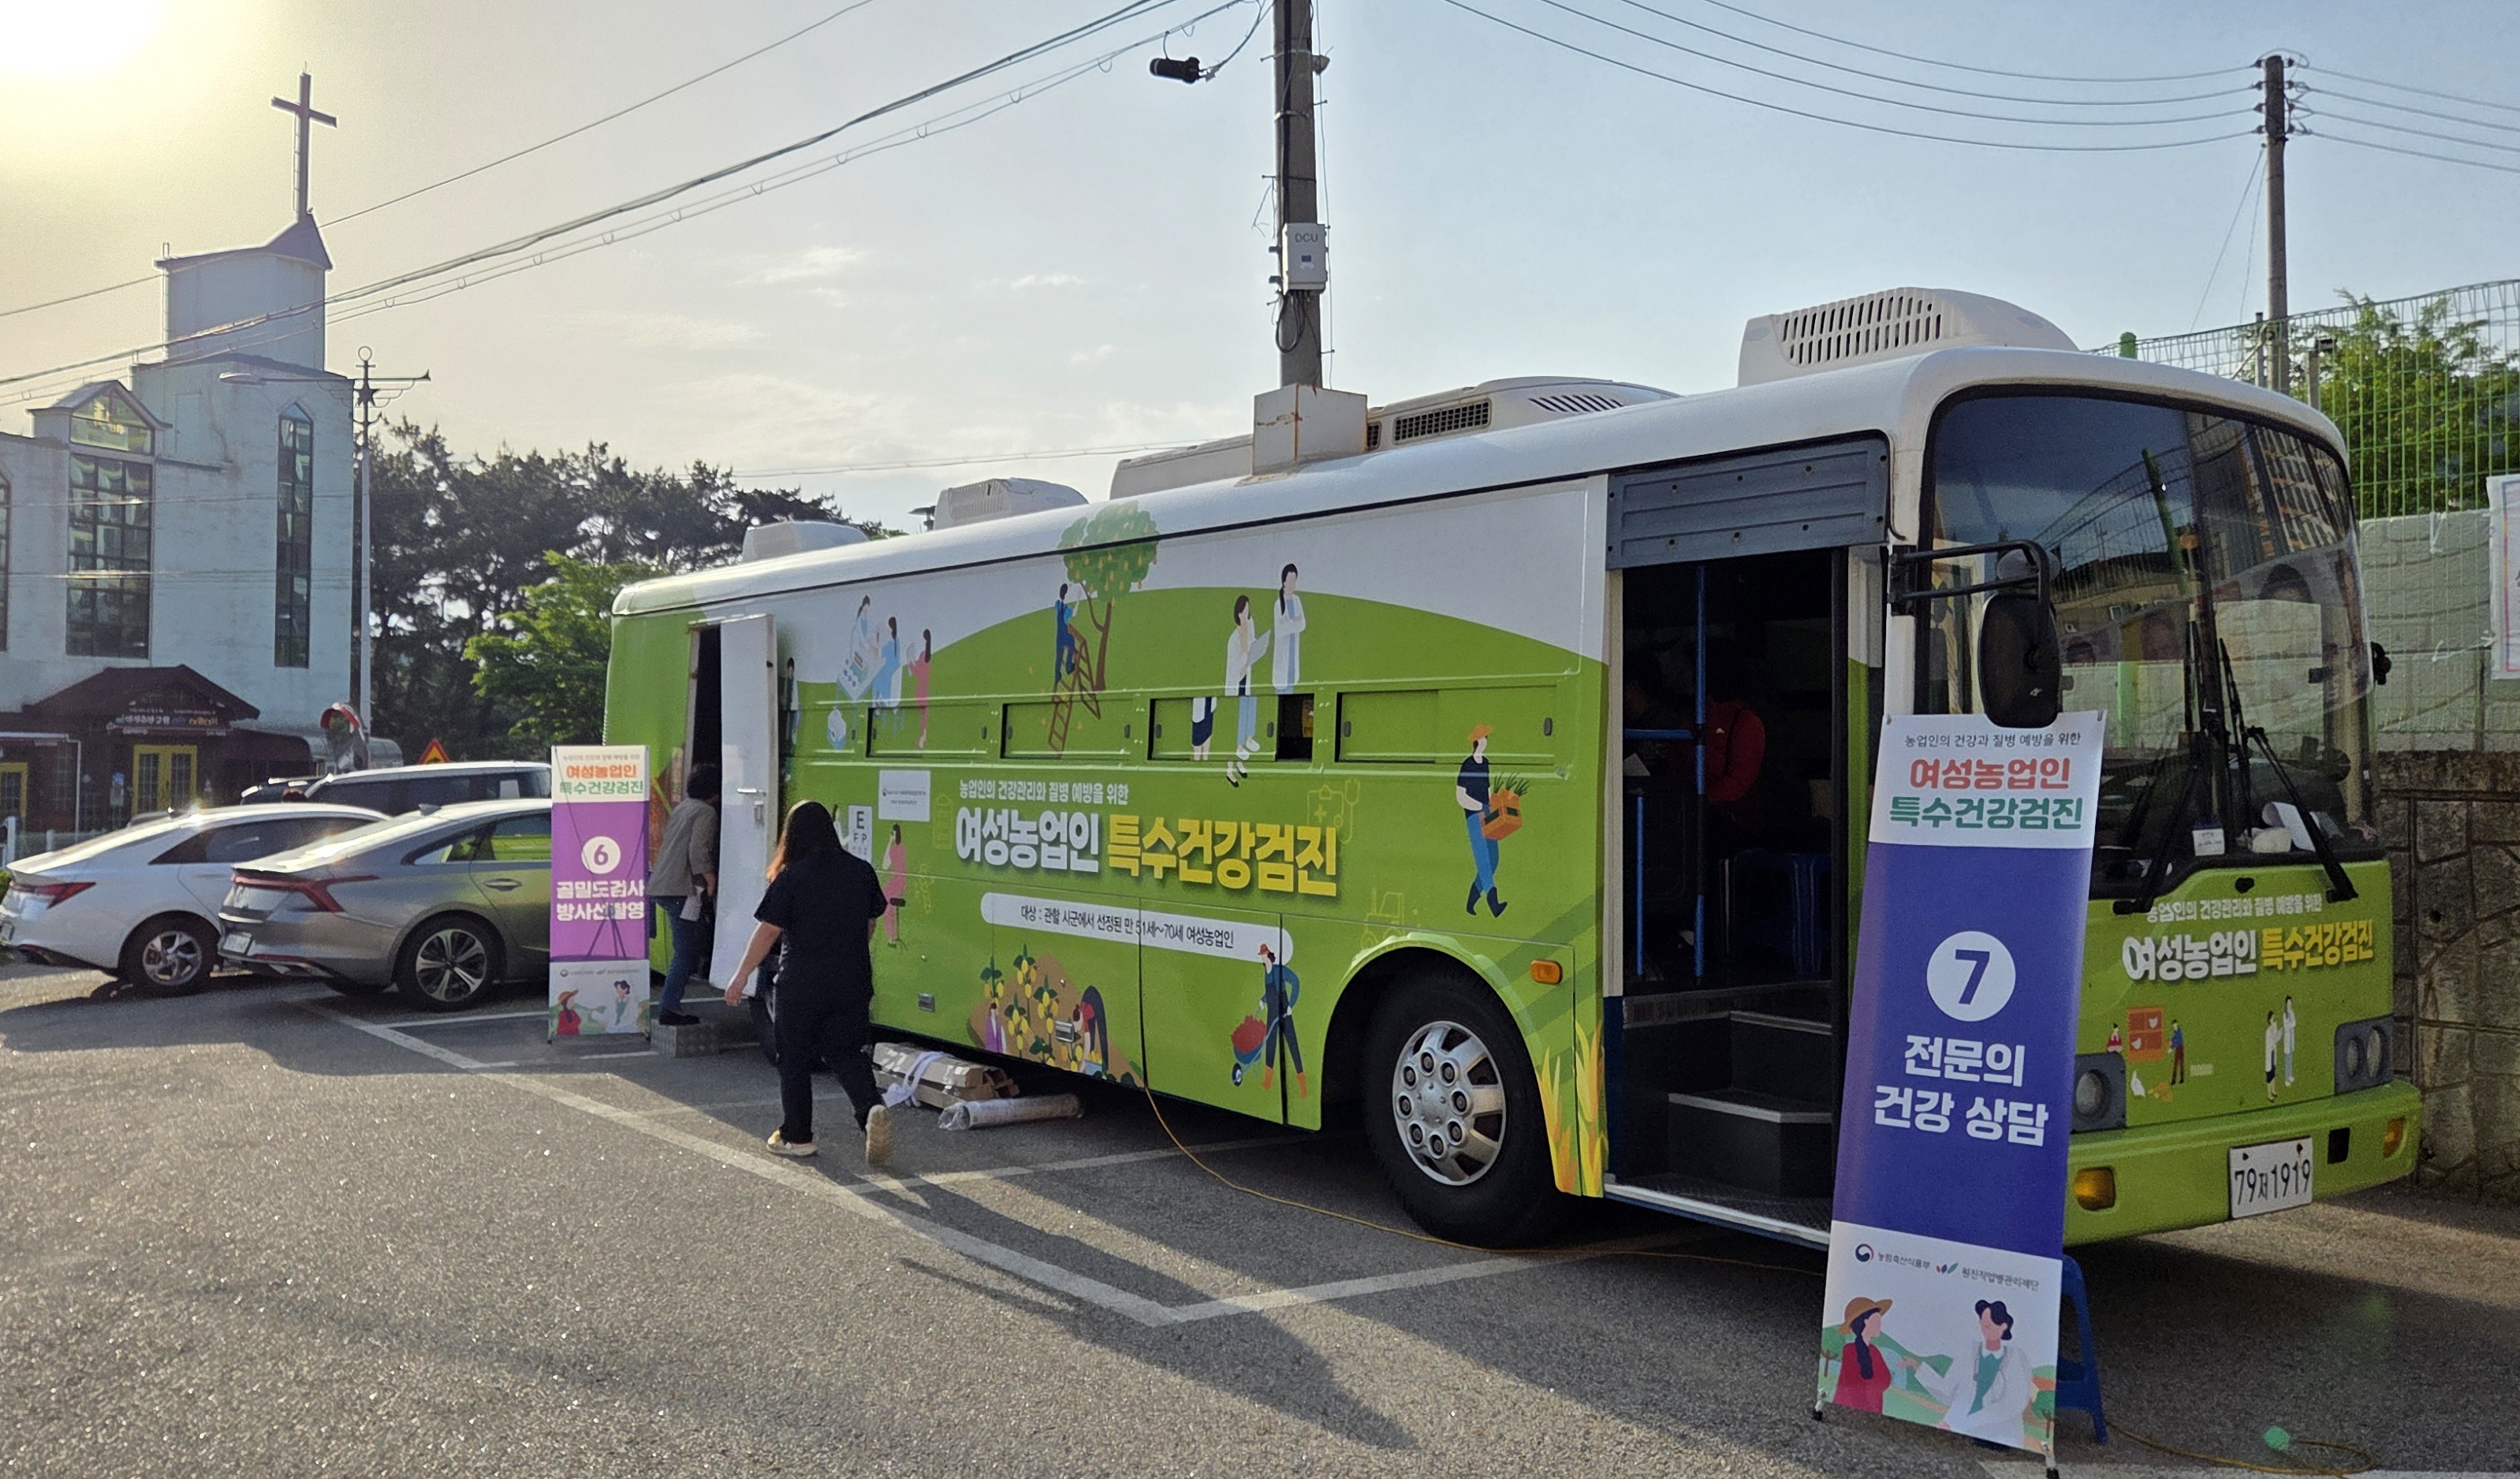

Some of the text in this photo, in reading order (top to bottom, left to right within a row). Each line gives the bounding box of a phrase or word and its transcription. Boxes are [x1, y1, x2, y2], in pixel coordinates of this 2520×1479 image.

[1295, 233, 1318, 243] DCU
[1904, 732, 2081, 748] 농업인의 건강과 질병 예방을 위한
[566, 764, 637, 779] 여성농업인
[1910, 758, 2071, 790] 여성농업인
[559, 780, 643, 795] 특수건강검진
[959, 779, 1129, 805] 농업인의 건강관리와 질병 예방을 위한
[856, 810, 865, 829] E
[1889, 795, 2083, 829] 특수건강검진
[594, 844, 609, 866] 6
[956, 807, 1336, 897] 여성농업인 특수건강검진
[557, 879, 645, 900] 골밀도검사
[1020, 904, 1036, 922] 대상
[1043, 907, 1061, 925] 관할
[1061, 910, 1095, 930] 시군에서
[1097, 914, 1122, 933] 선정된
[1124, 917, 1134, 935] 만
[1186, 926, 1234, 949] 여성농업인
[2122, 918, 2373, 981] 여성농업인 특수건강검진
[1955, 948, 1991, 1005] 7
[1904, 1034, 2025, 1087] 전문의
[1874, 1085, 2049, 1147] 건강 상담
